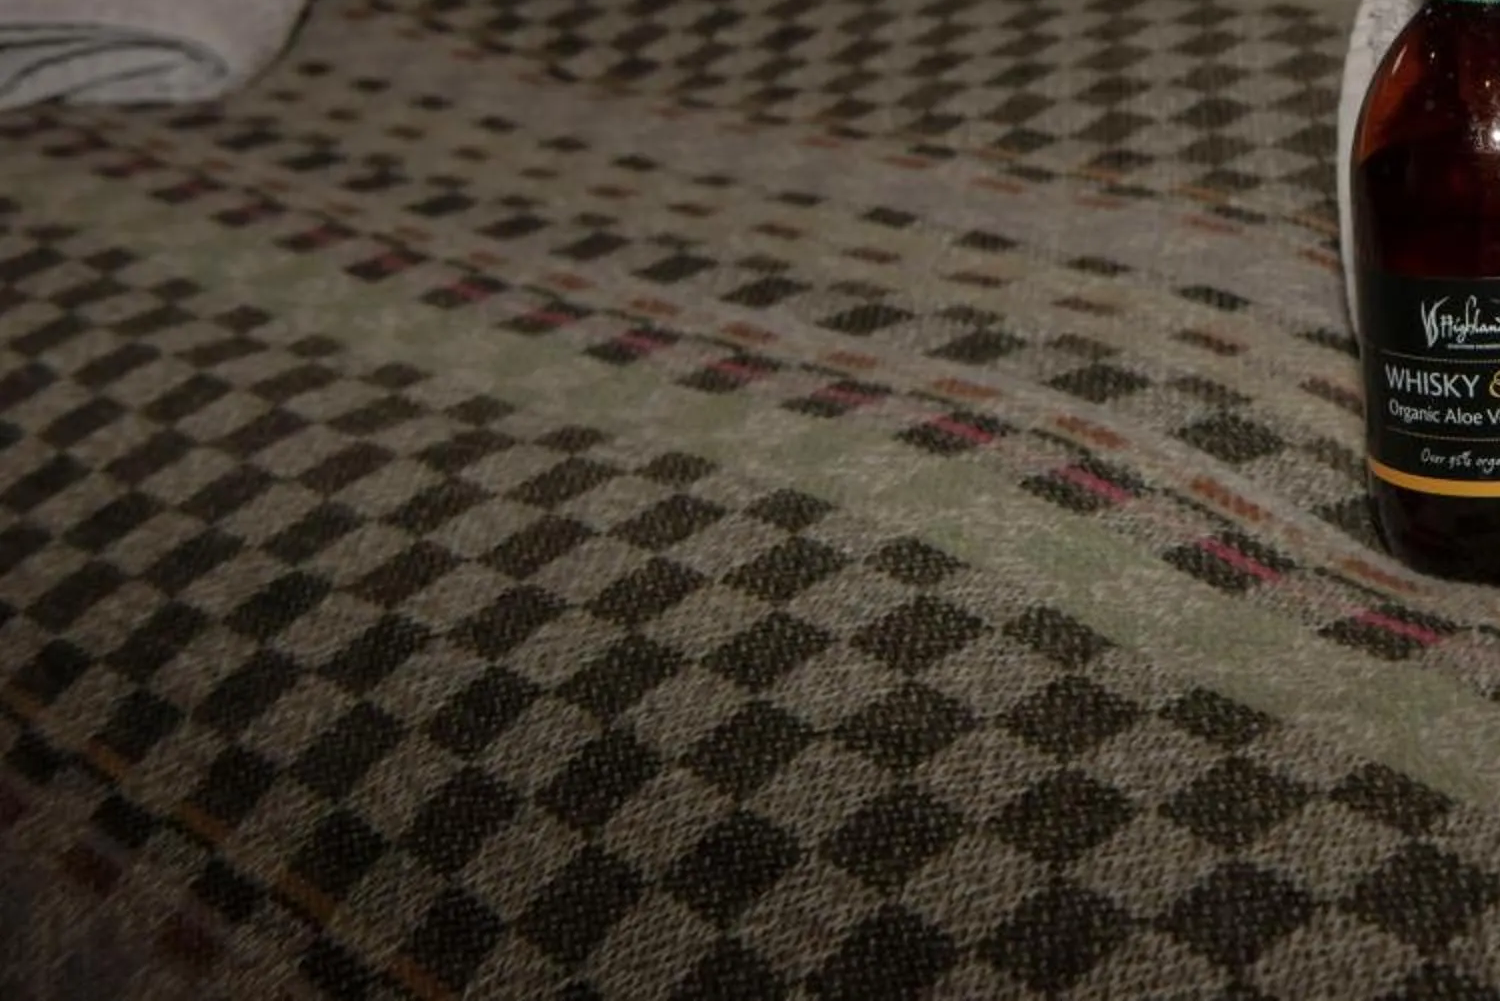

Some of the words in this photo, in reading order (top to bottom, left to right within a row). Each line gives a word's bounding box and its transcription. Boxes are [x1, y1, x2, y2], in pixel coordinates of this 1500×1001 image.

[1384, 362, 1480, 399] WHISKY
[1388, 398, 1441, 424] Organic
[1443, 409, 1484, 426] Aloe
